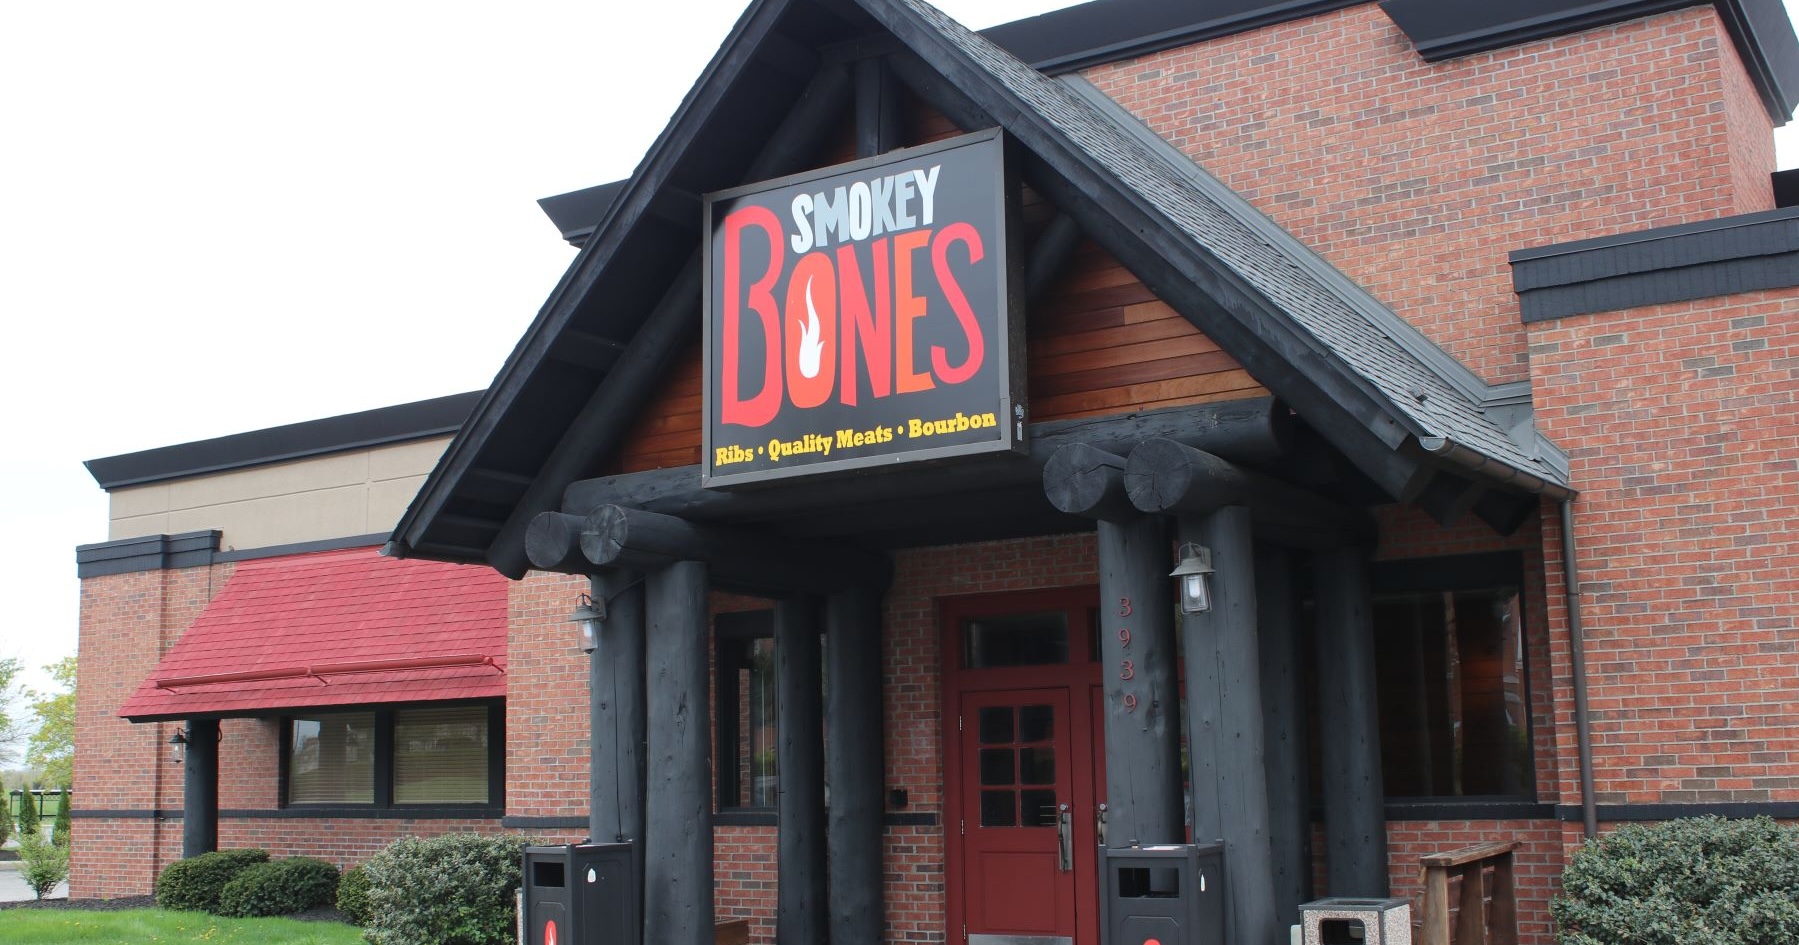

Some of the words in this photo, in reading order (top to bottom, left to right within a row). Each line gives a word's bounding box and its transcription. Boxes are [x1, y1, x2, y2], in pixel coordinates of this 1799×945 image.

[791, 165, 941, 254] SMOKEY
[721, 205, 986, 428] BONES
[715, 445, 755, 467] Ribs
[768, 434, 833, 462] Quality
[836, 427, 893, 449] Meats
[908, 412, 997, 439] Bourbon
[1118, 597, 1137, 714] 3939
